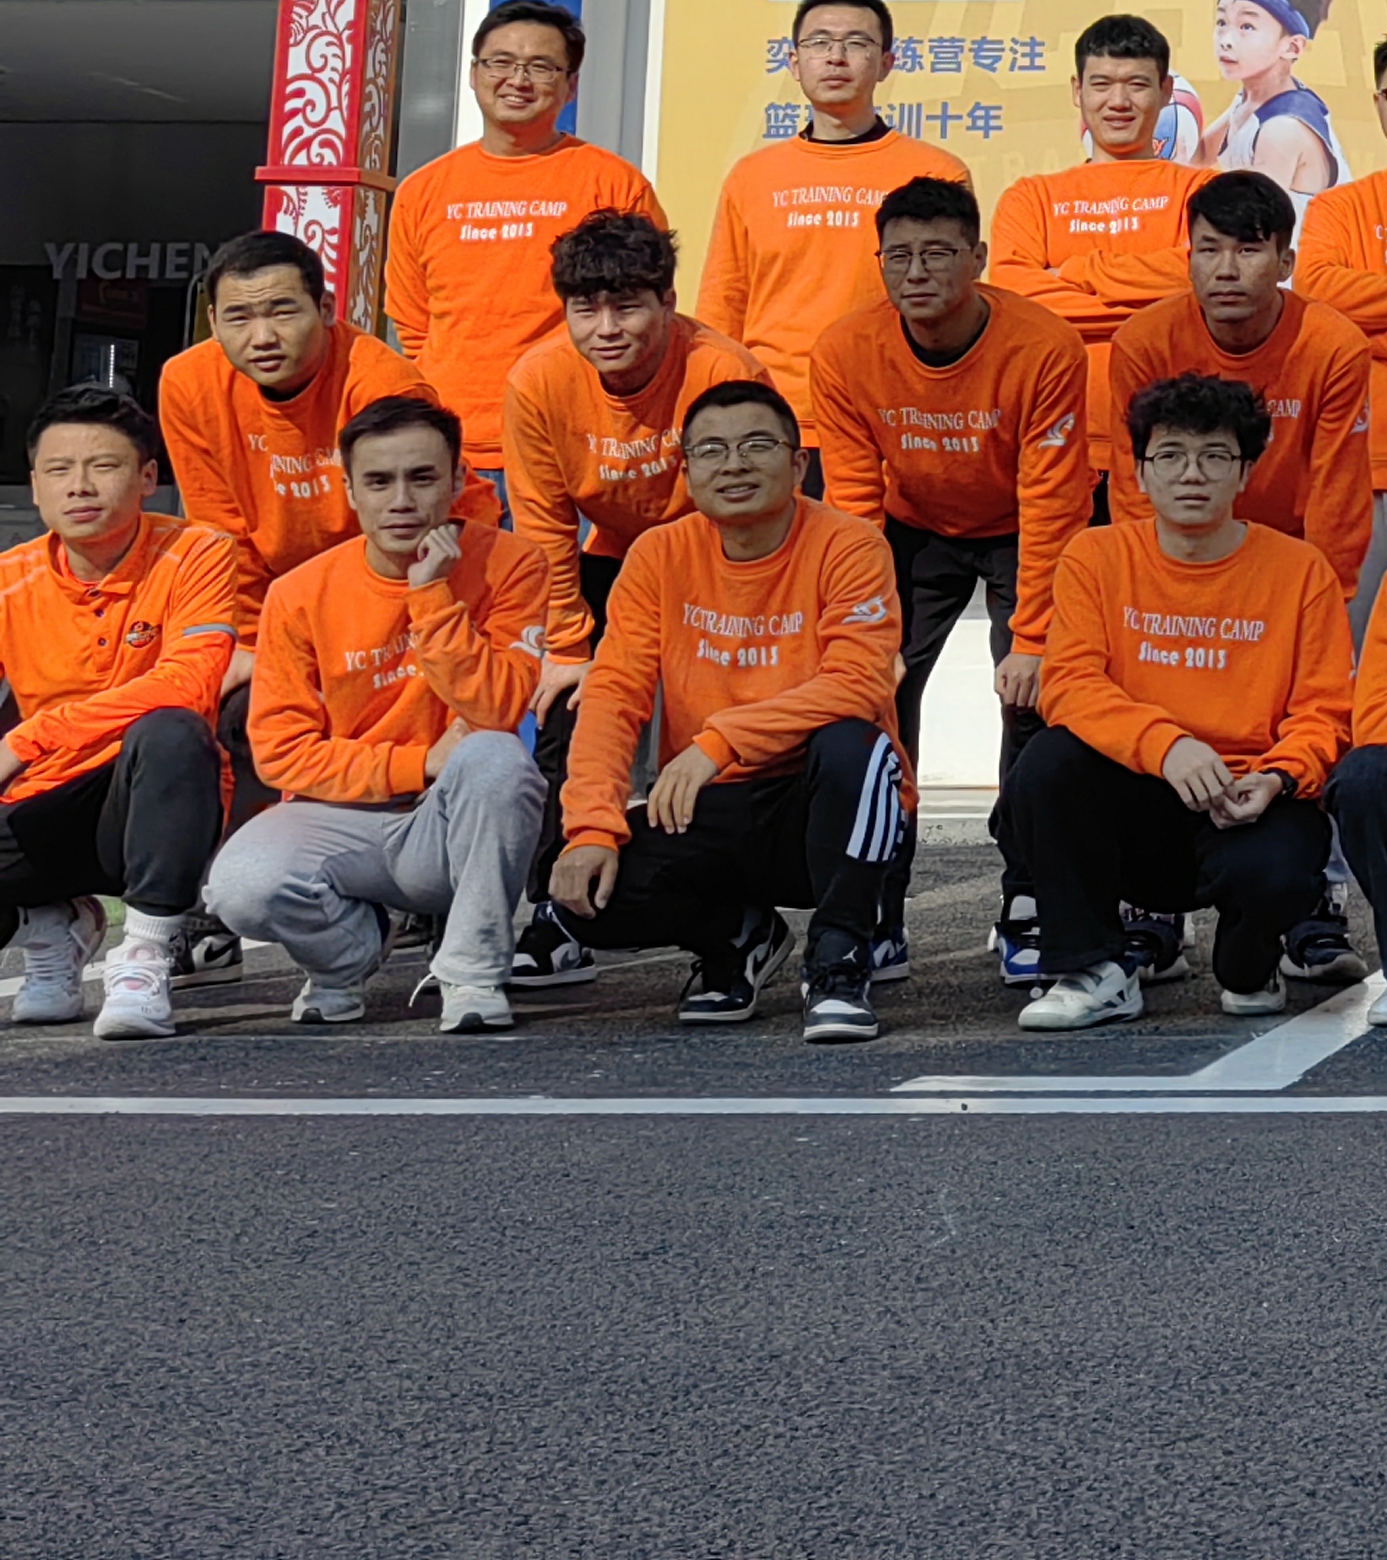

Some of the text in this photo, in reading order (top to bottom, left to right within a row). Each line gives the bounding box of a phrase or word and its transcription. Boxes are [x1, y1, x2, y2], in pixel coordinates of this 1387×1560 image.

[772, 186, 853, 208] YC TRAINING
[1053, 196, 1170, 216] YC TRAINING CAMP
[466, 201, 526, 218] TRAINING
[529, 201, 568, 217] CAMP
[787, 210, 860, 228] Since 2013
[459, 222, 534, 241] Since 2013
[1069, 219, 1106, 233] Since
[967, 408, 1002, 430] CAMP
[247, 433, 269, 453] YC
[942, 436, 980, 454] 2013
[290, 474, 331, 499] 2013
[1122, 605, 1265, 641] YC TRAINING CAMP
[344, 651, 367, 671] YC
[737, 645, 778, 668] 2013
[1138, 641, 1227, 670] Since 2013
[372, 663, 417, 689] Since
